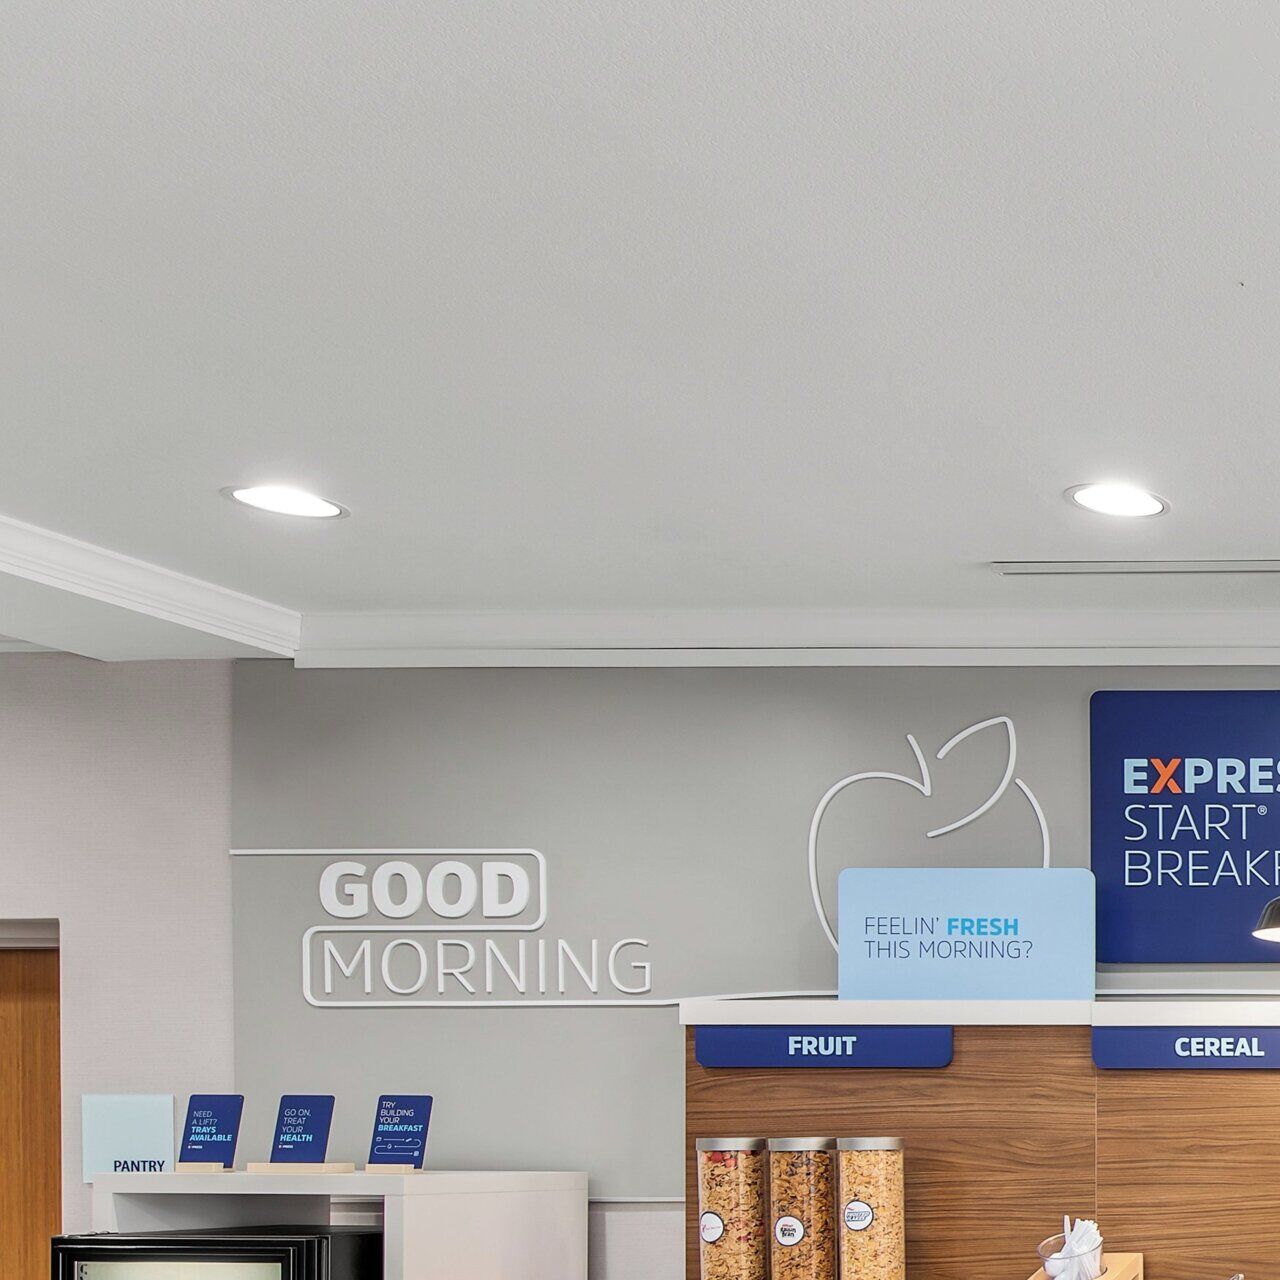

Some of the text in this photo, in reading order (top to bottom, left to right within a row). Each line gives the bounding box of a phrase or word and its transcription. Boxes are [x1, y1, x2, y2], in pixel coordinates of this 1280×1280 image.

[319, 861, 530, 918] GOOD
[947, 917, 1019, 936] FRESH
[864, 941, 1033, 960] THIS MORNING?
[322, 939, 653, 995] MORNING
[787, 1035, 856, 1057] FRUIT
[1174, 1036, 1265, 1058] CEREAL
[284, 1109, 296, 1117] GO
[284, 1117, 306, 1125] TREAT
[380, 1109, 414, 1117] BUILDING
[189, 1134, 232, 1142] AVAILABLE
[280, 1134, 313, 1142] HEALTH
[114, 1160, 165, 1173] PANTRY
